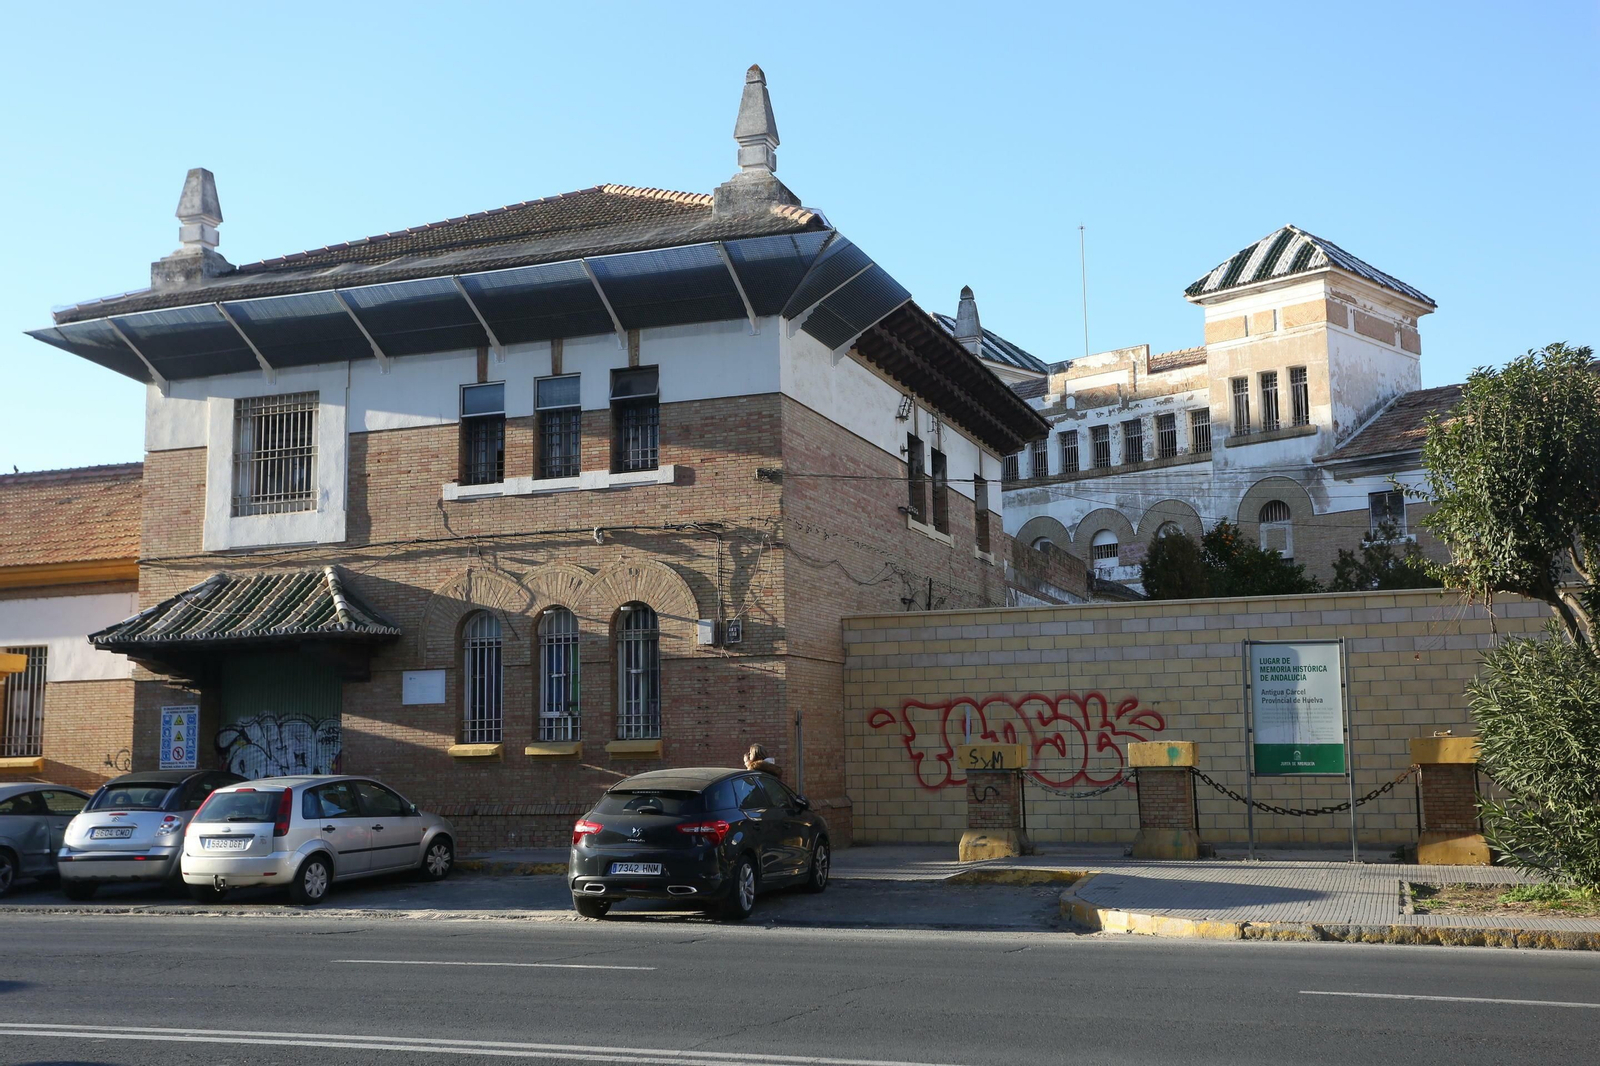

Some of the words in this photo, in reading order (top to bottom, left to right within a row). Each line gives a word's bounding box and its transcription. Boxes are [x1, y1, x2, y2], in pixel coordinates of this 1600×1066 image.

[1293, 664, 1328, 673] HISTÓRICA
[1270, 673, 1307, 681] ANDALUCÍA
[1261, 688, 1284, 696] Antigua
[618, 864, 639, 873] 7342
[642, 864, 659, 873] HNM
